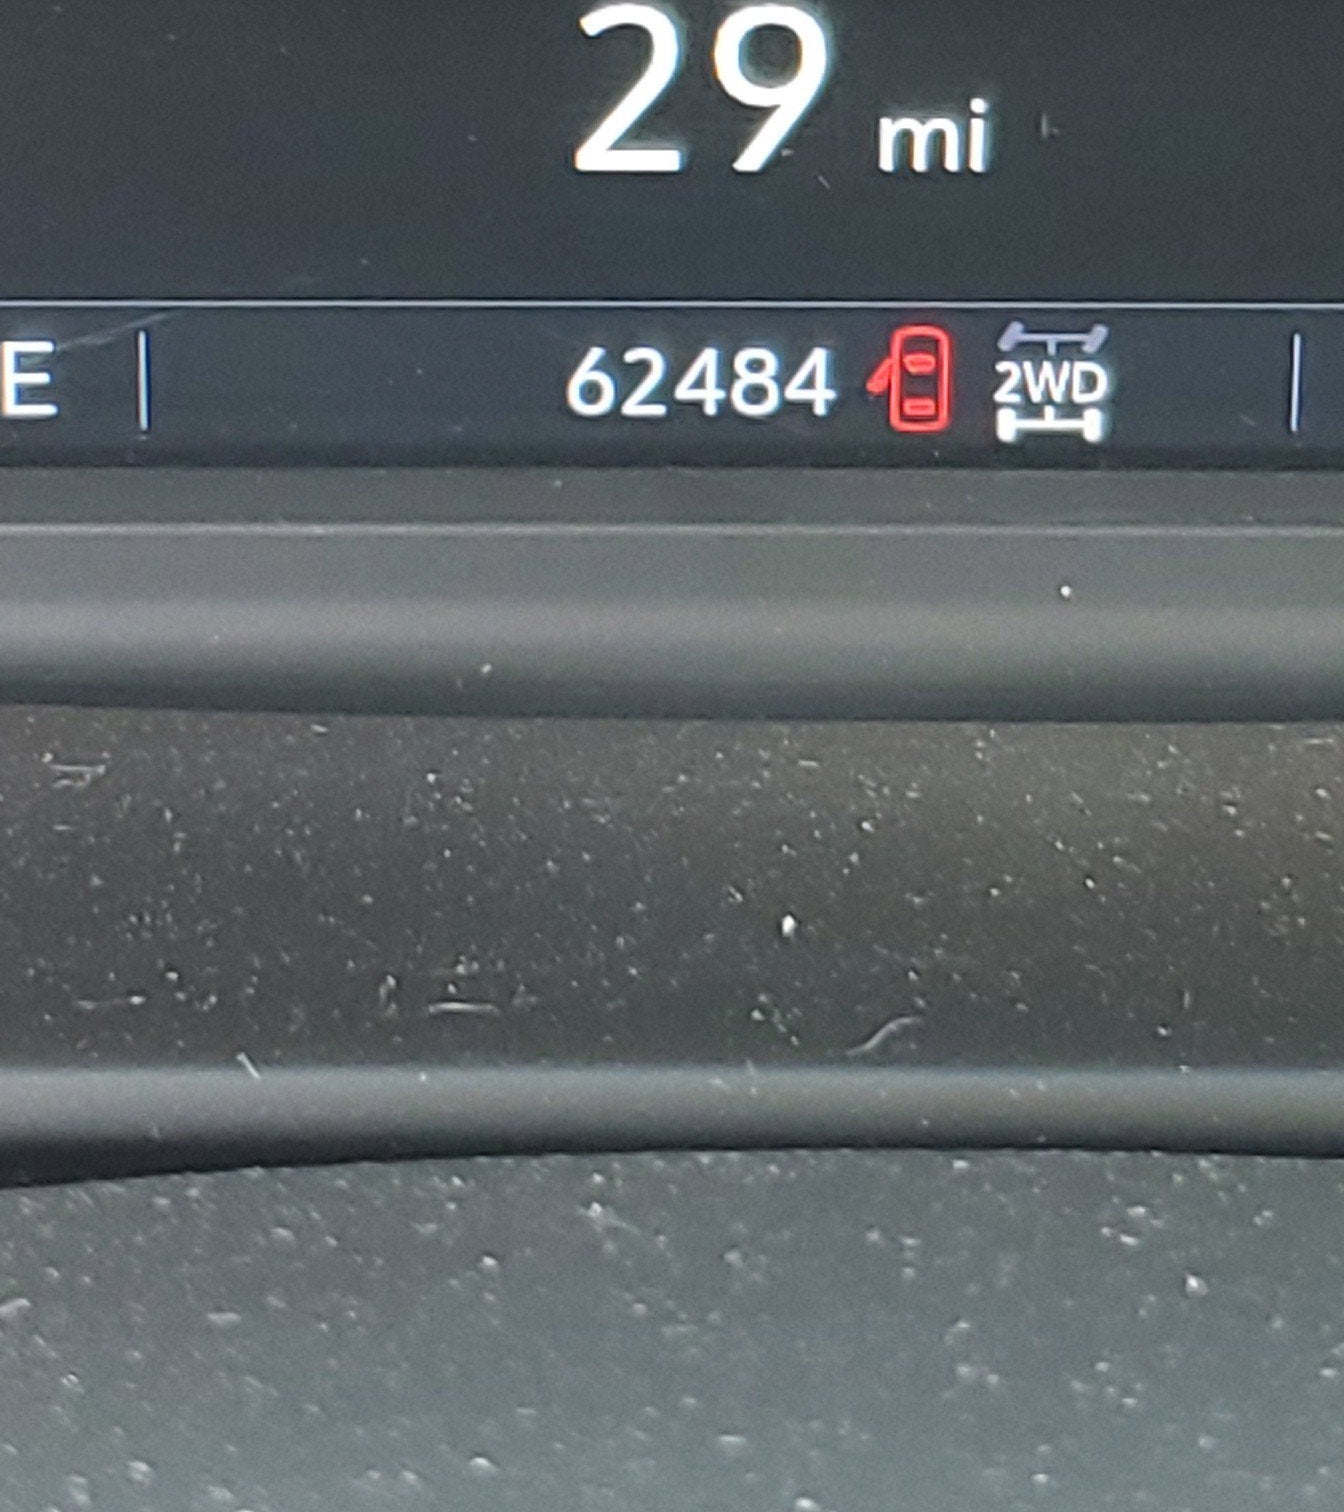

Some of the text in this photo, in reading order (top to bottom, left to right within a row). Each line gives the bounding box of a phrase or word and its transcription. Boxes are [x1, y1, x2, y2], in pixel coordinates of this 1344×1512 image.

[574, 0, 991, 174] 29 mi
[566, 346, 837, 418] 62484
[993, 360, 1109, 404] 2WD
